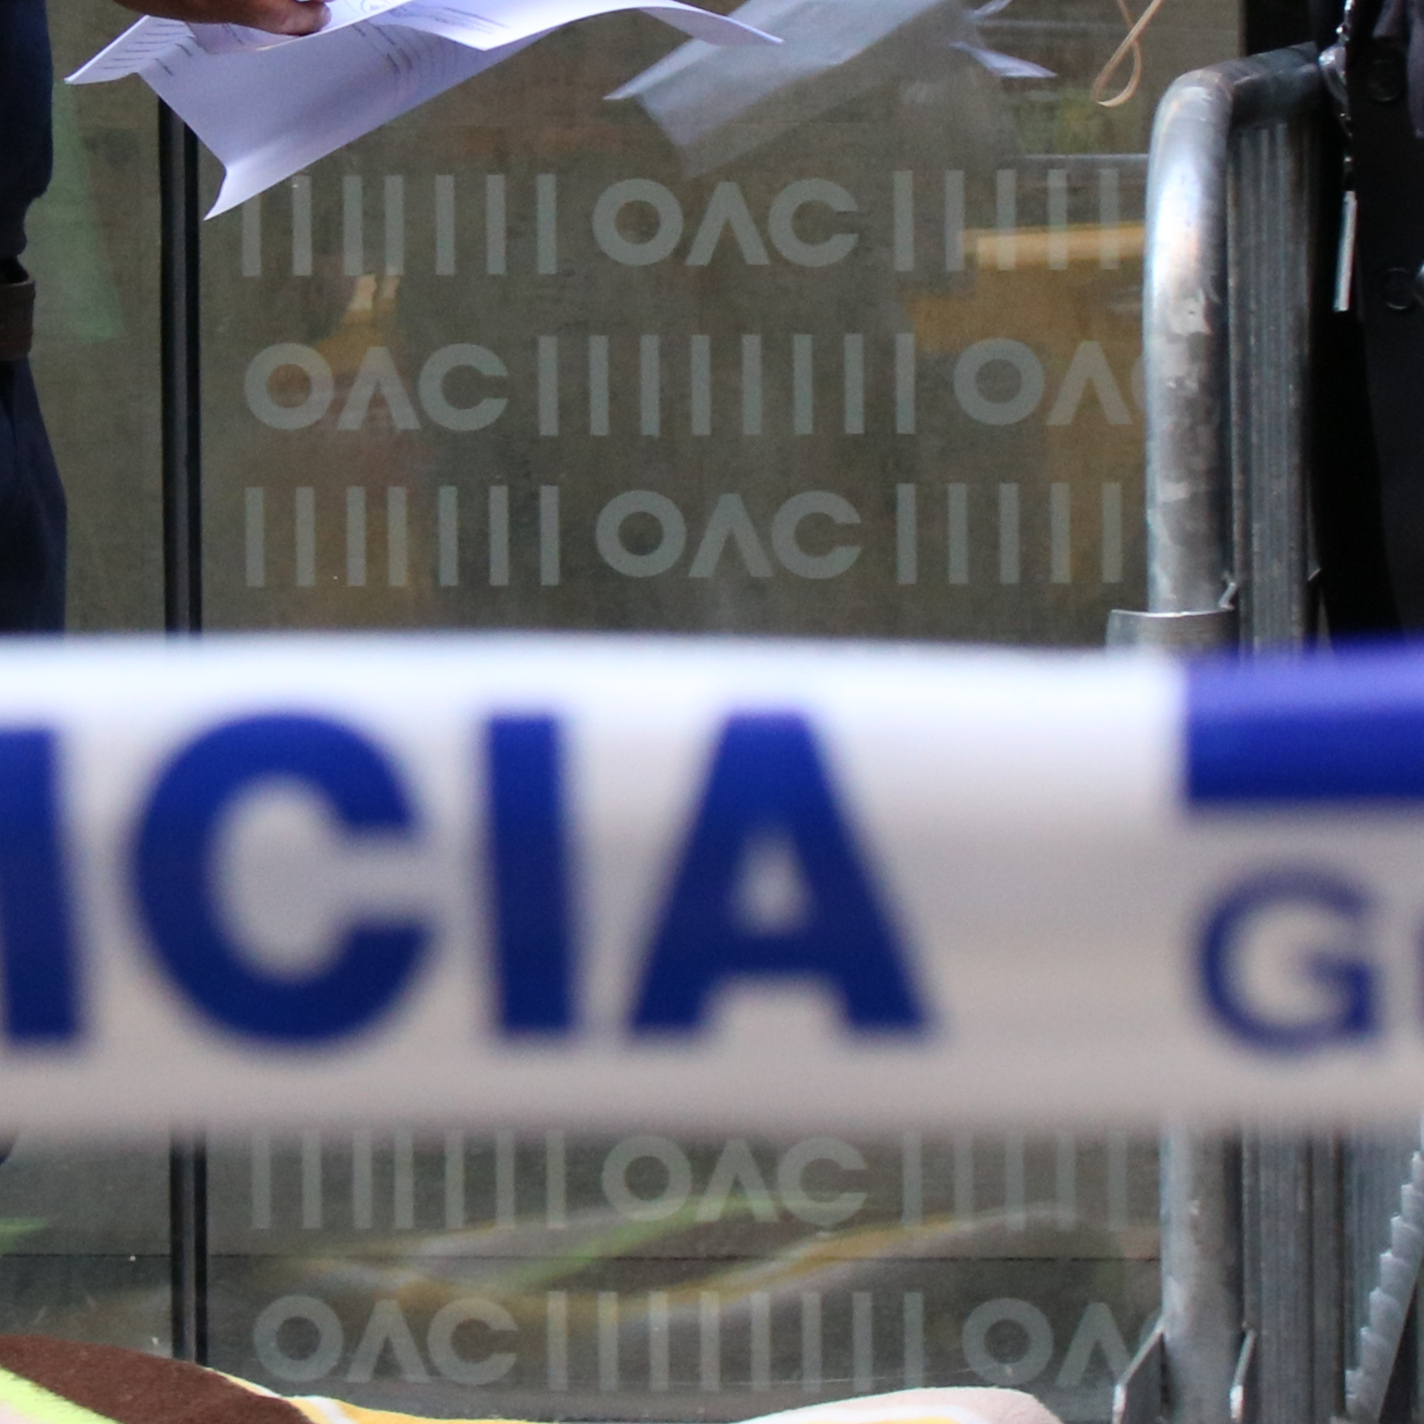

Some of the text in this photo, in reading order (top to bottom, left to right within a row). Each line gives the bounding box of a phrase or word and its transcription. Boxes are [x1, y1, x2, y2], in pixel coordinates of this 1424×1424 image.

[592, 176, 860, 268] OAC
[244, 341, 509, 433] OAC
[594, 488, 863, 580] OAC
[600, 1133, 868, 1226] OAC
[252, 1294, 518, 1387] OAC
